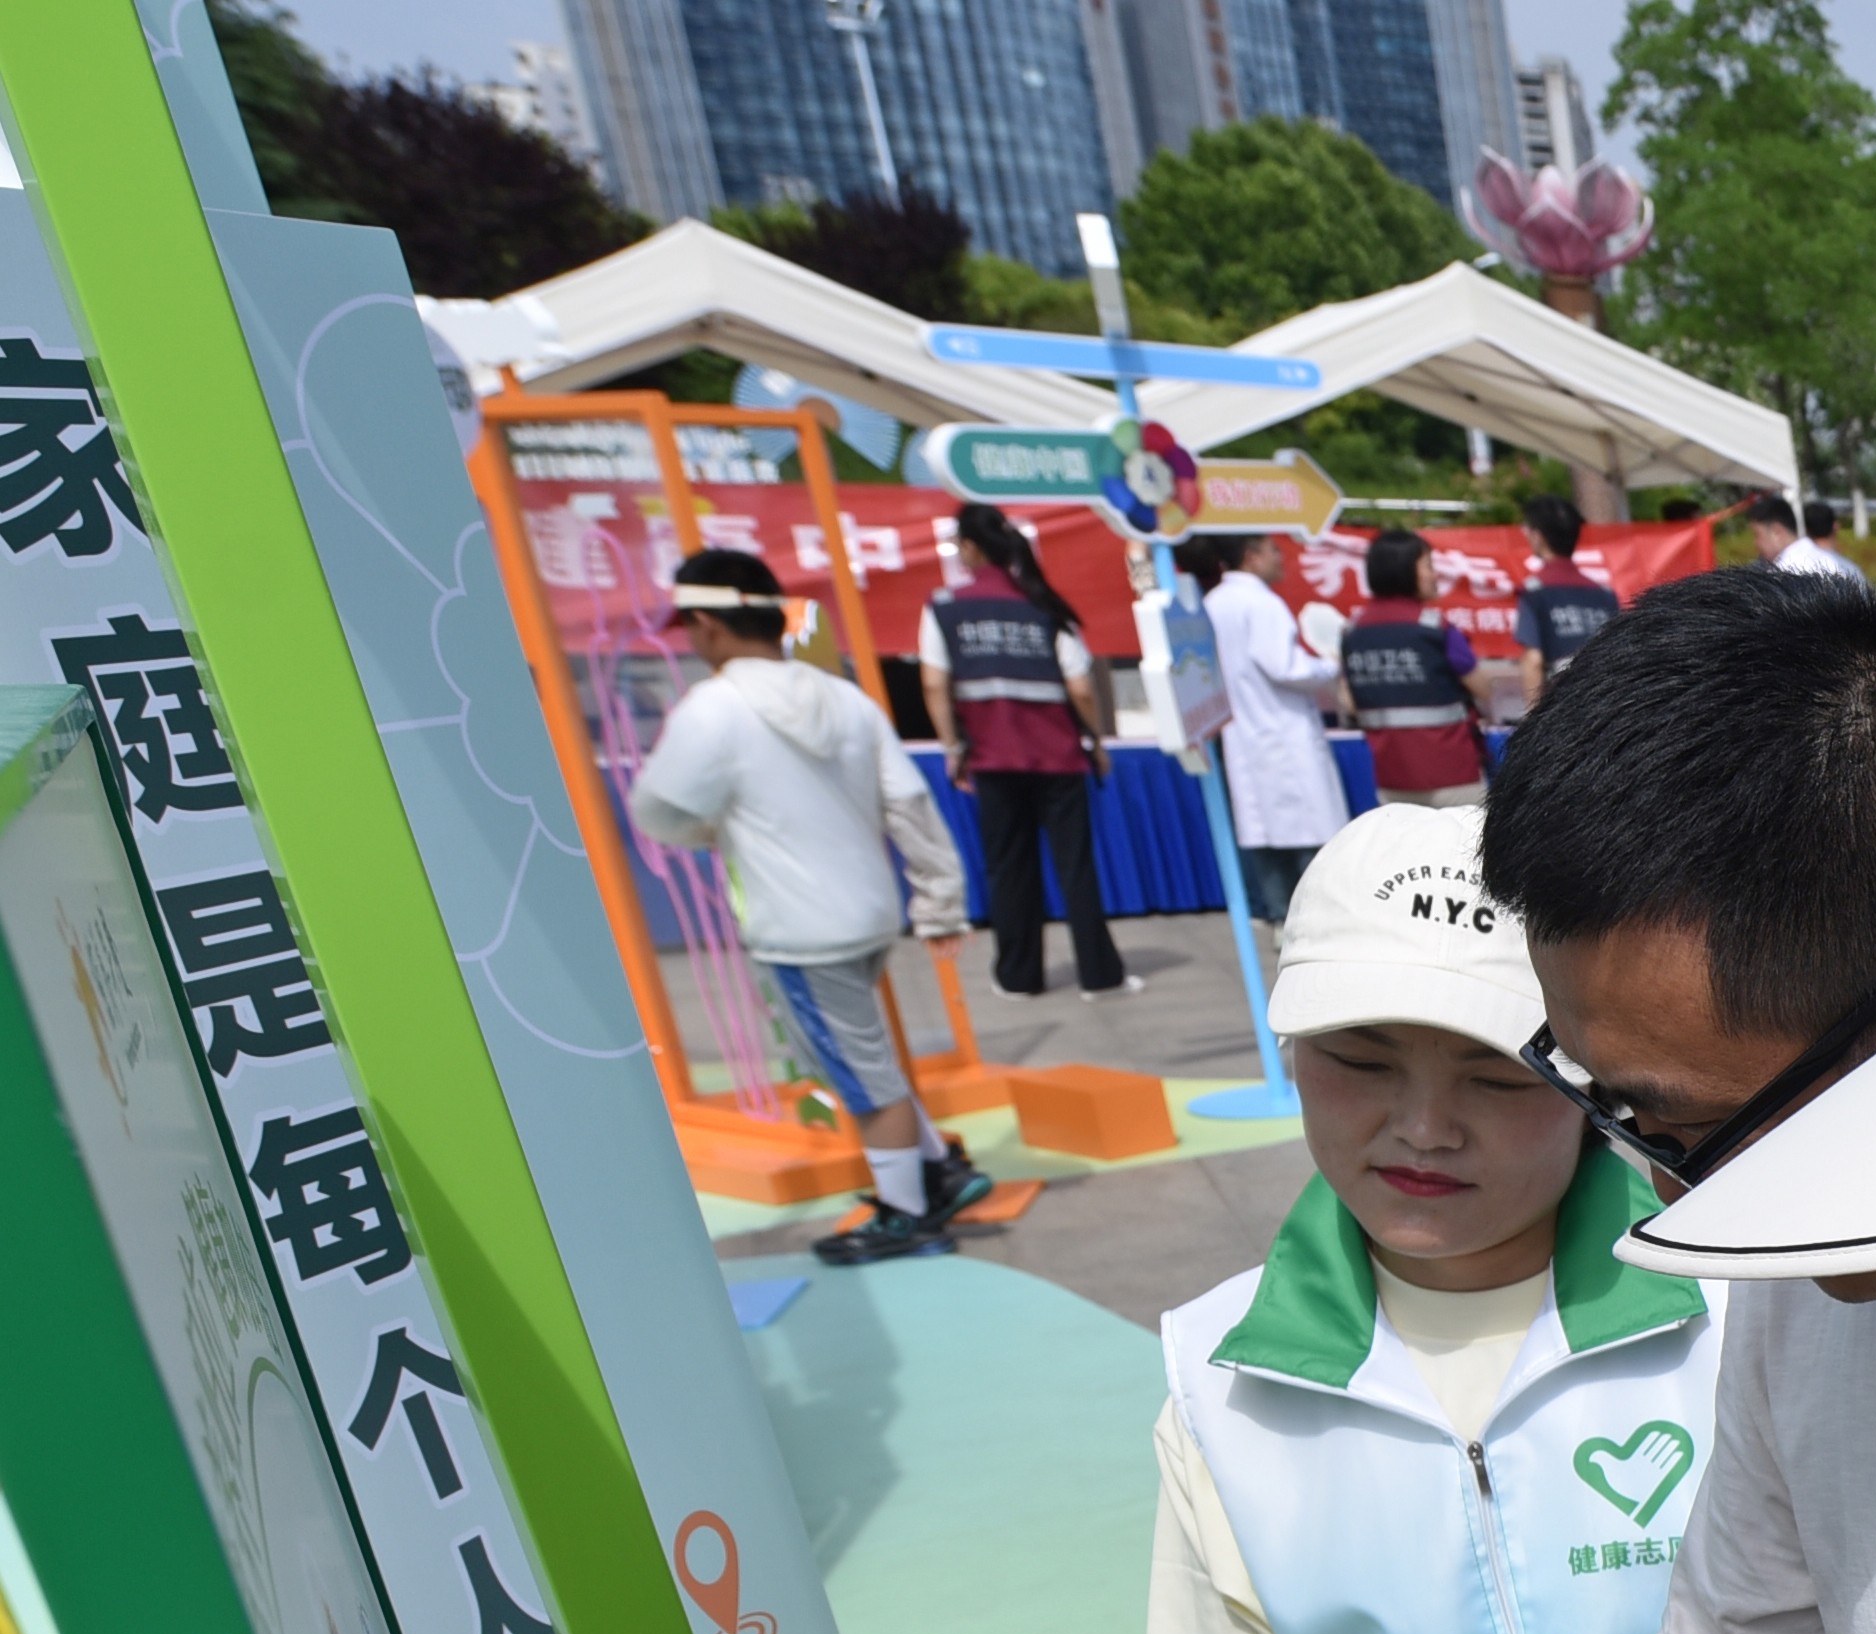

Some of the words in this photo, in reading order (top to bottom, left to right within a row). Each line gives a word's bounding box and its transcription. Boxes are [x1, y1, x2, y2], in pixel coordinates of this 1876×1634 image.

[1374, 865, 1432, 901] UPPER
[1440, 866, 1482, 886] EAS
[1411, 893, 1496, 934] N.Y.C
